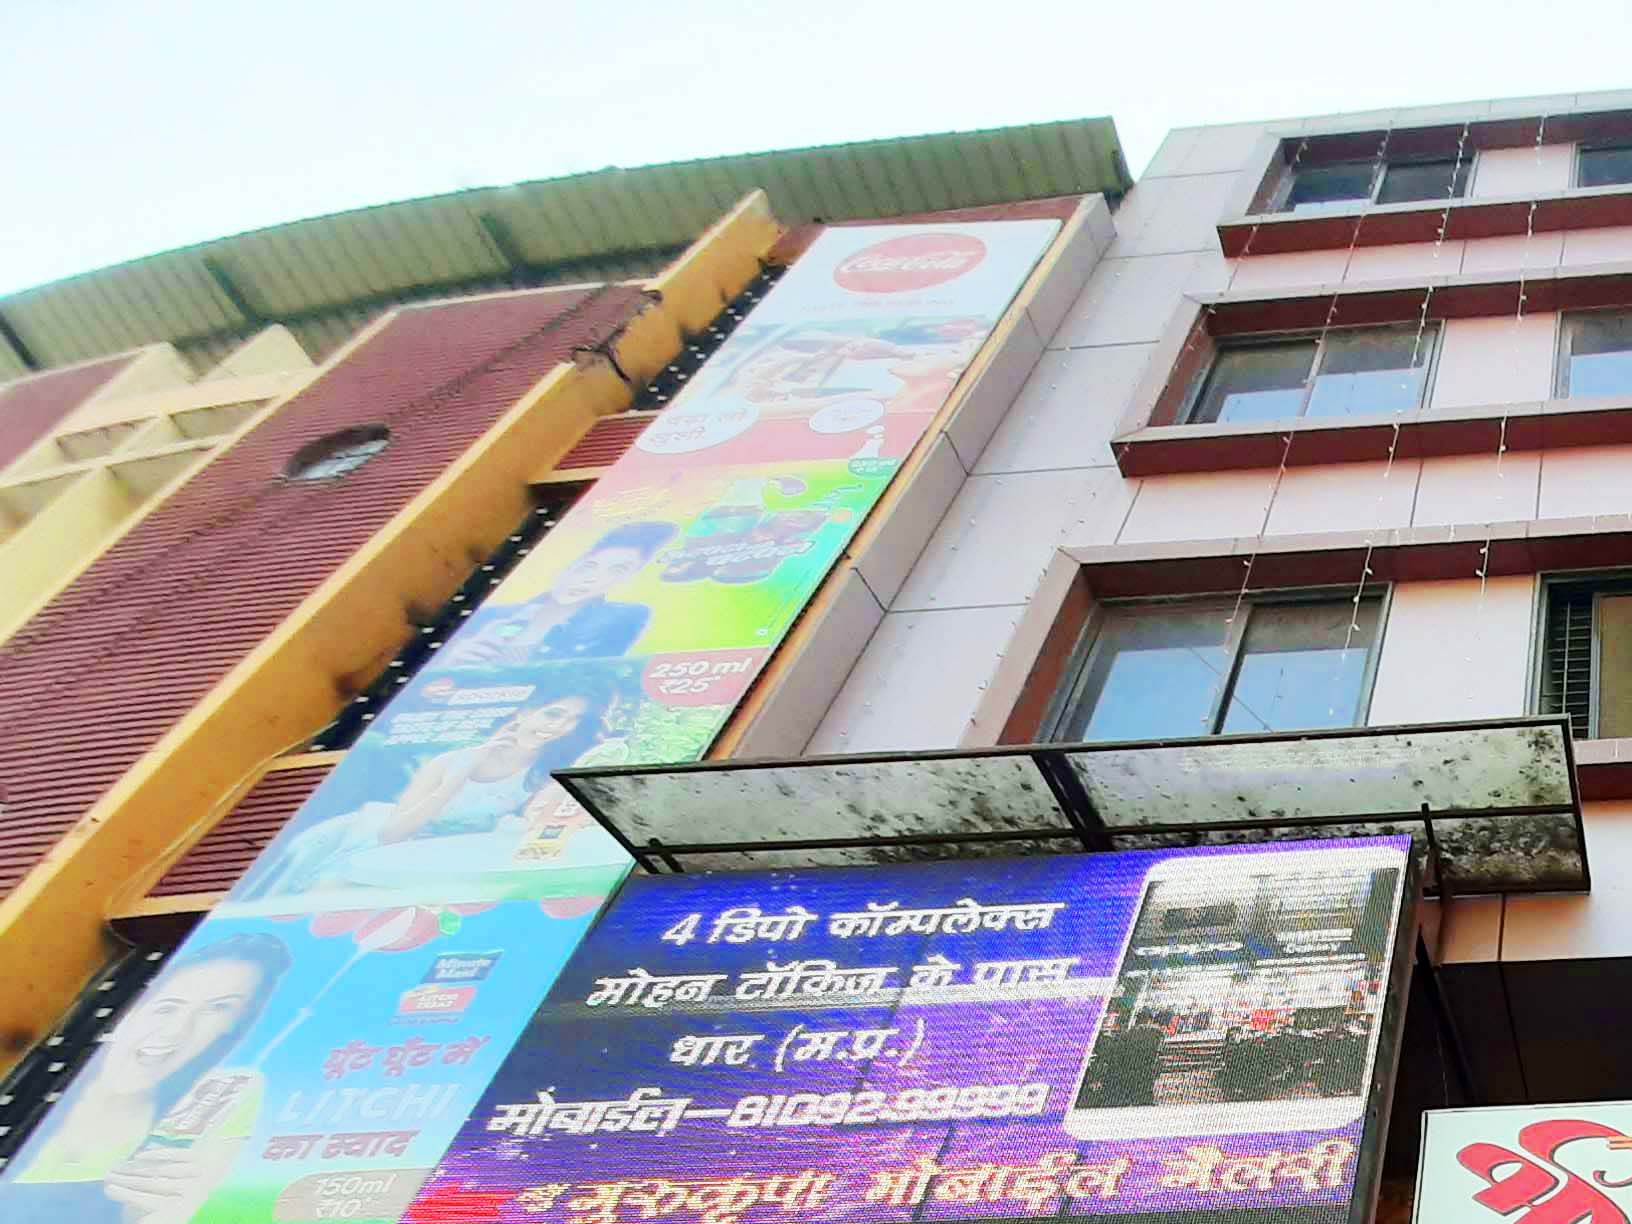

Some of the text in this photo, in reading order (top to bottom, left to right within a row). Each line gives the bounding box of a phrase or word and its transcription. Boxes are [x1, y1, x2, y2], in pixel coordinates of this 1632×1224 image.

[661, 912, 702, 946] 4
[909, 954, 961, 991] के
[971, 956, 1080, 990] पास
[670, 1033, 765, 1066] धार
[278, 1083, 463, 1125] LITCHI
